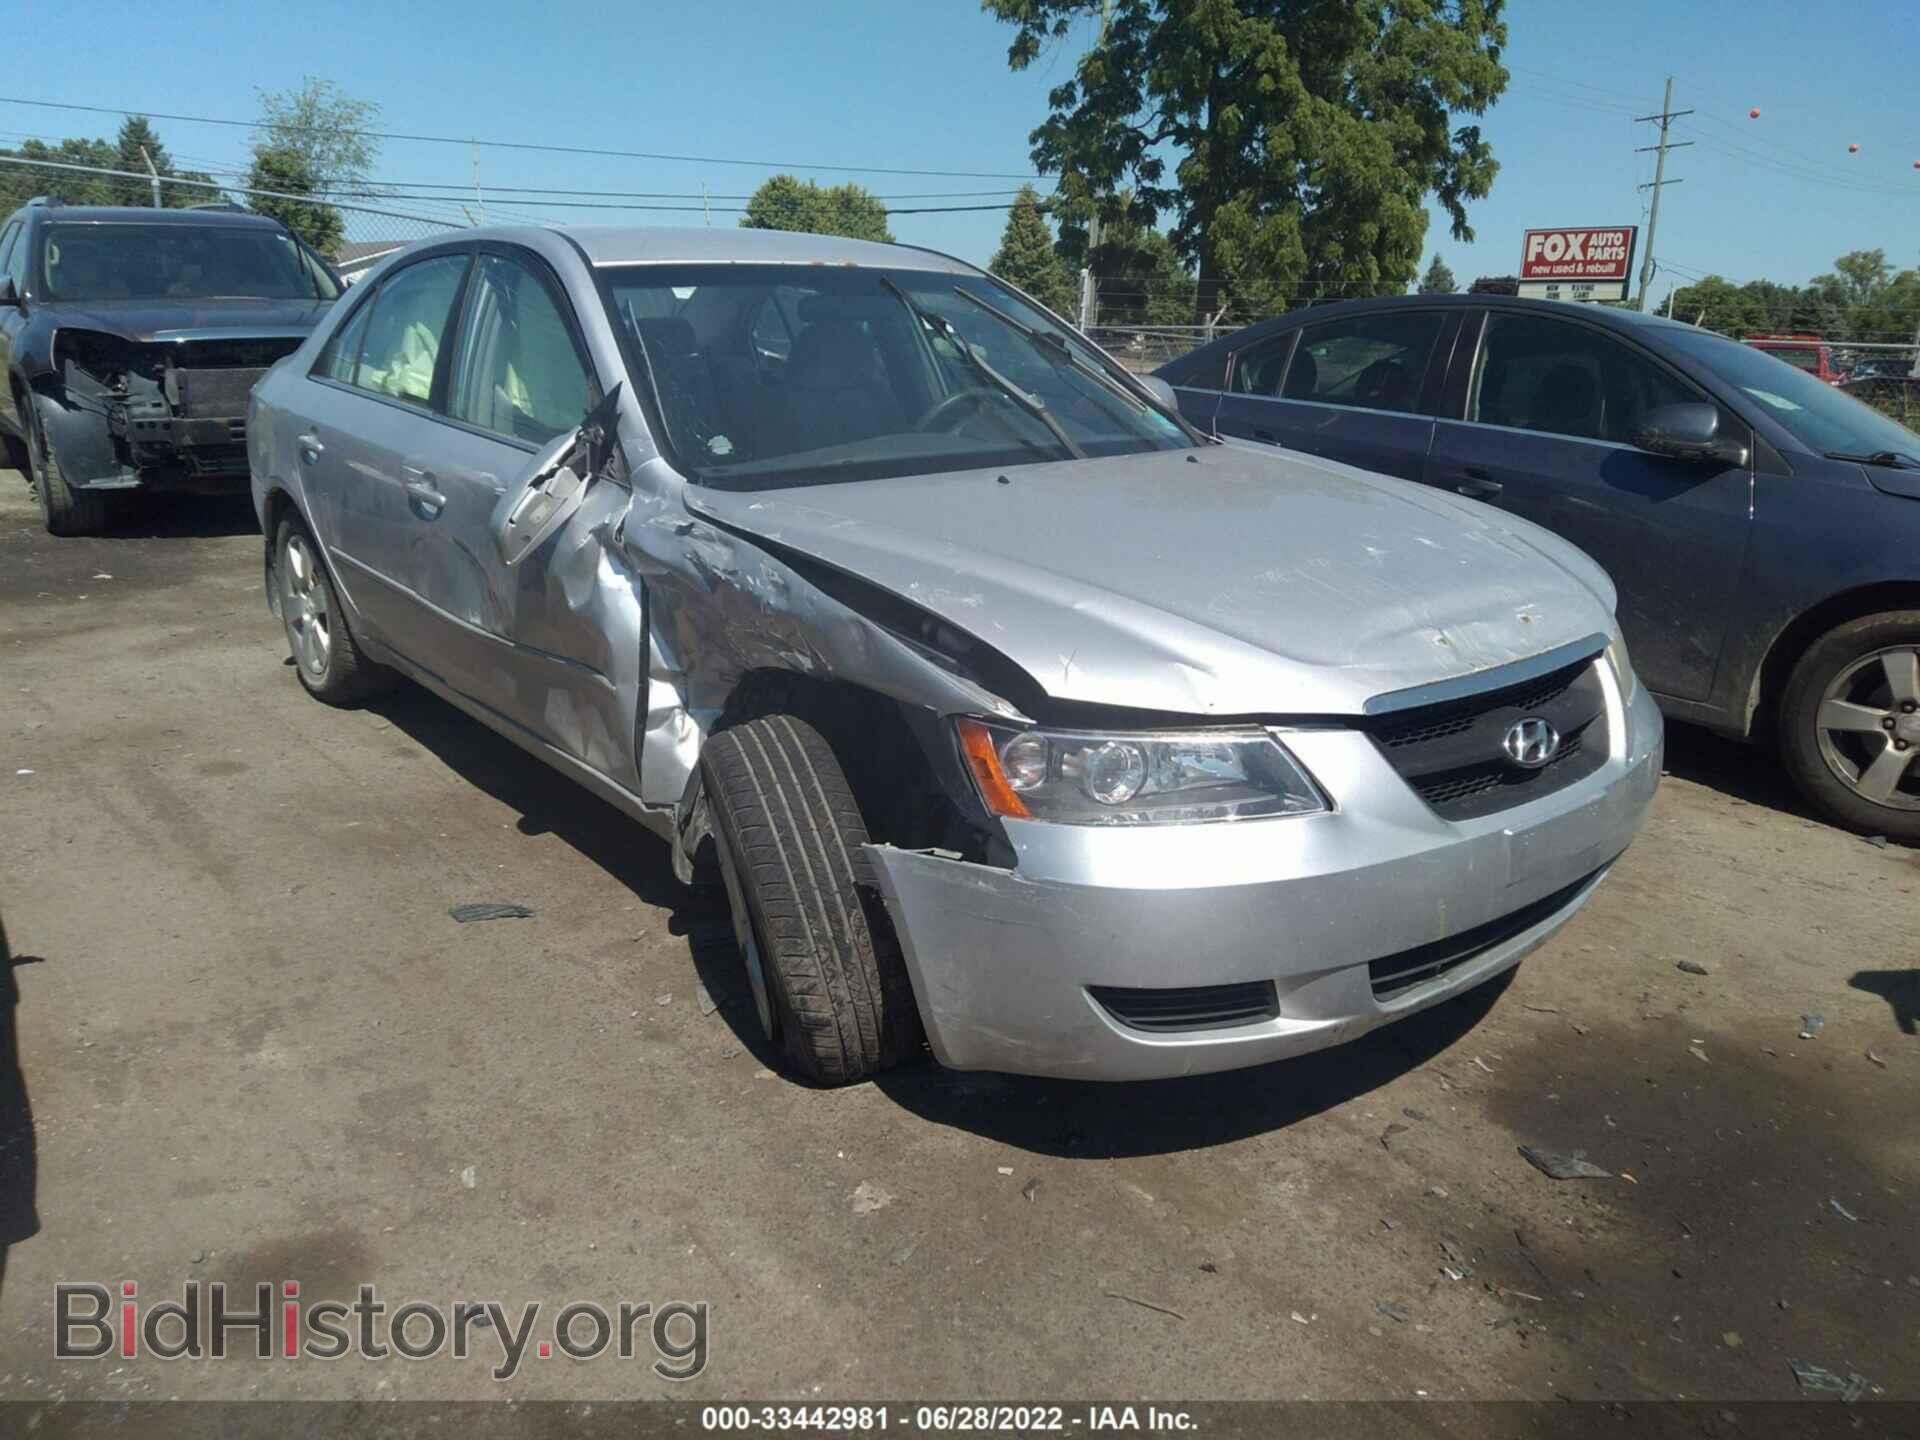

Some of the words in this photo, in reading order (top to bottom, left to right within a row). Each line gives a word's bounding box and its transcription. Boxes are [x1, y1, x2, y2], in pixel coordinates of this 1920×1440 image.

[1589, 232, 1624, 246] AUTO
[1527, 233, 1587, 262] FOX
[1587, 247, 1625, 260] PARTS
[1531, 264, 1552, 274] new
[1552, 262, 1576, 273] used
[1576, 262, 1584, 272] &
